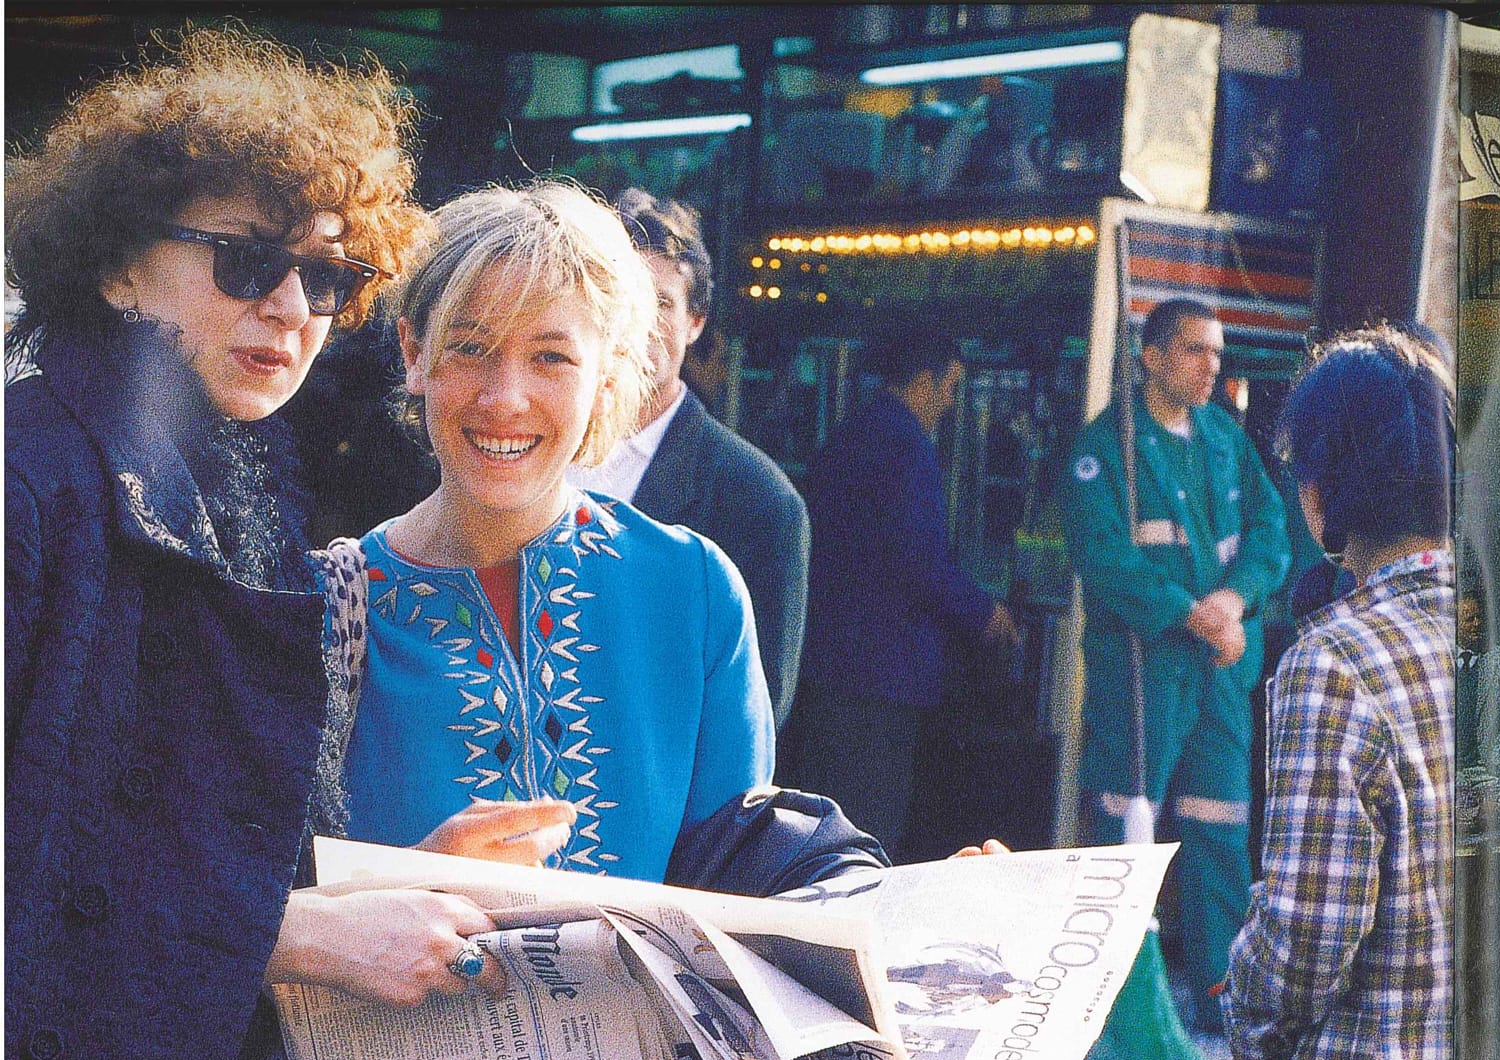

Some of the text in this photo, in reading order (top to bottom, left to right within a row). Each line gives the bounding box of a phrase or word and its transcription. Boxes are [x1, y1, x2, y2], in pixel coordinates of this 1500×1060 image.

[506, 1002, 525, 1038] capital
[492, 1031, 504, 1053] aux
[514, 1038, 529, 1053] de
